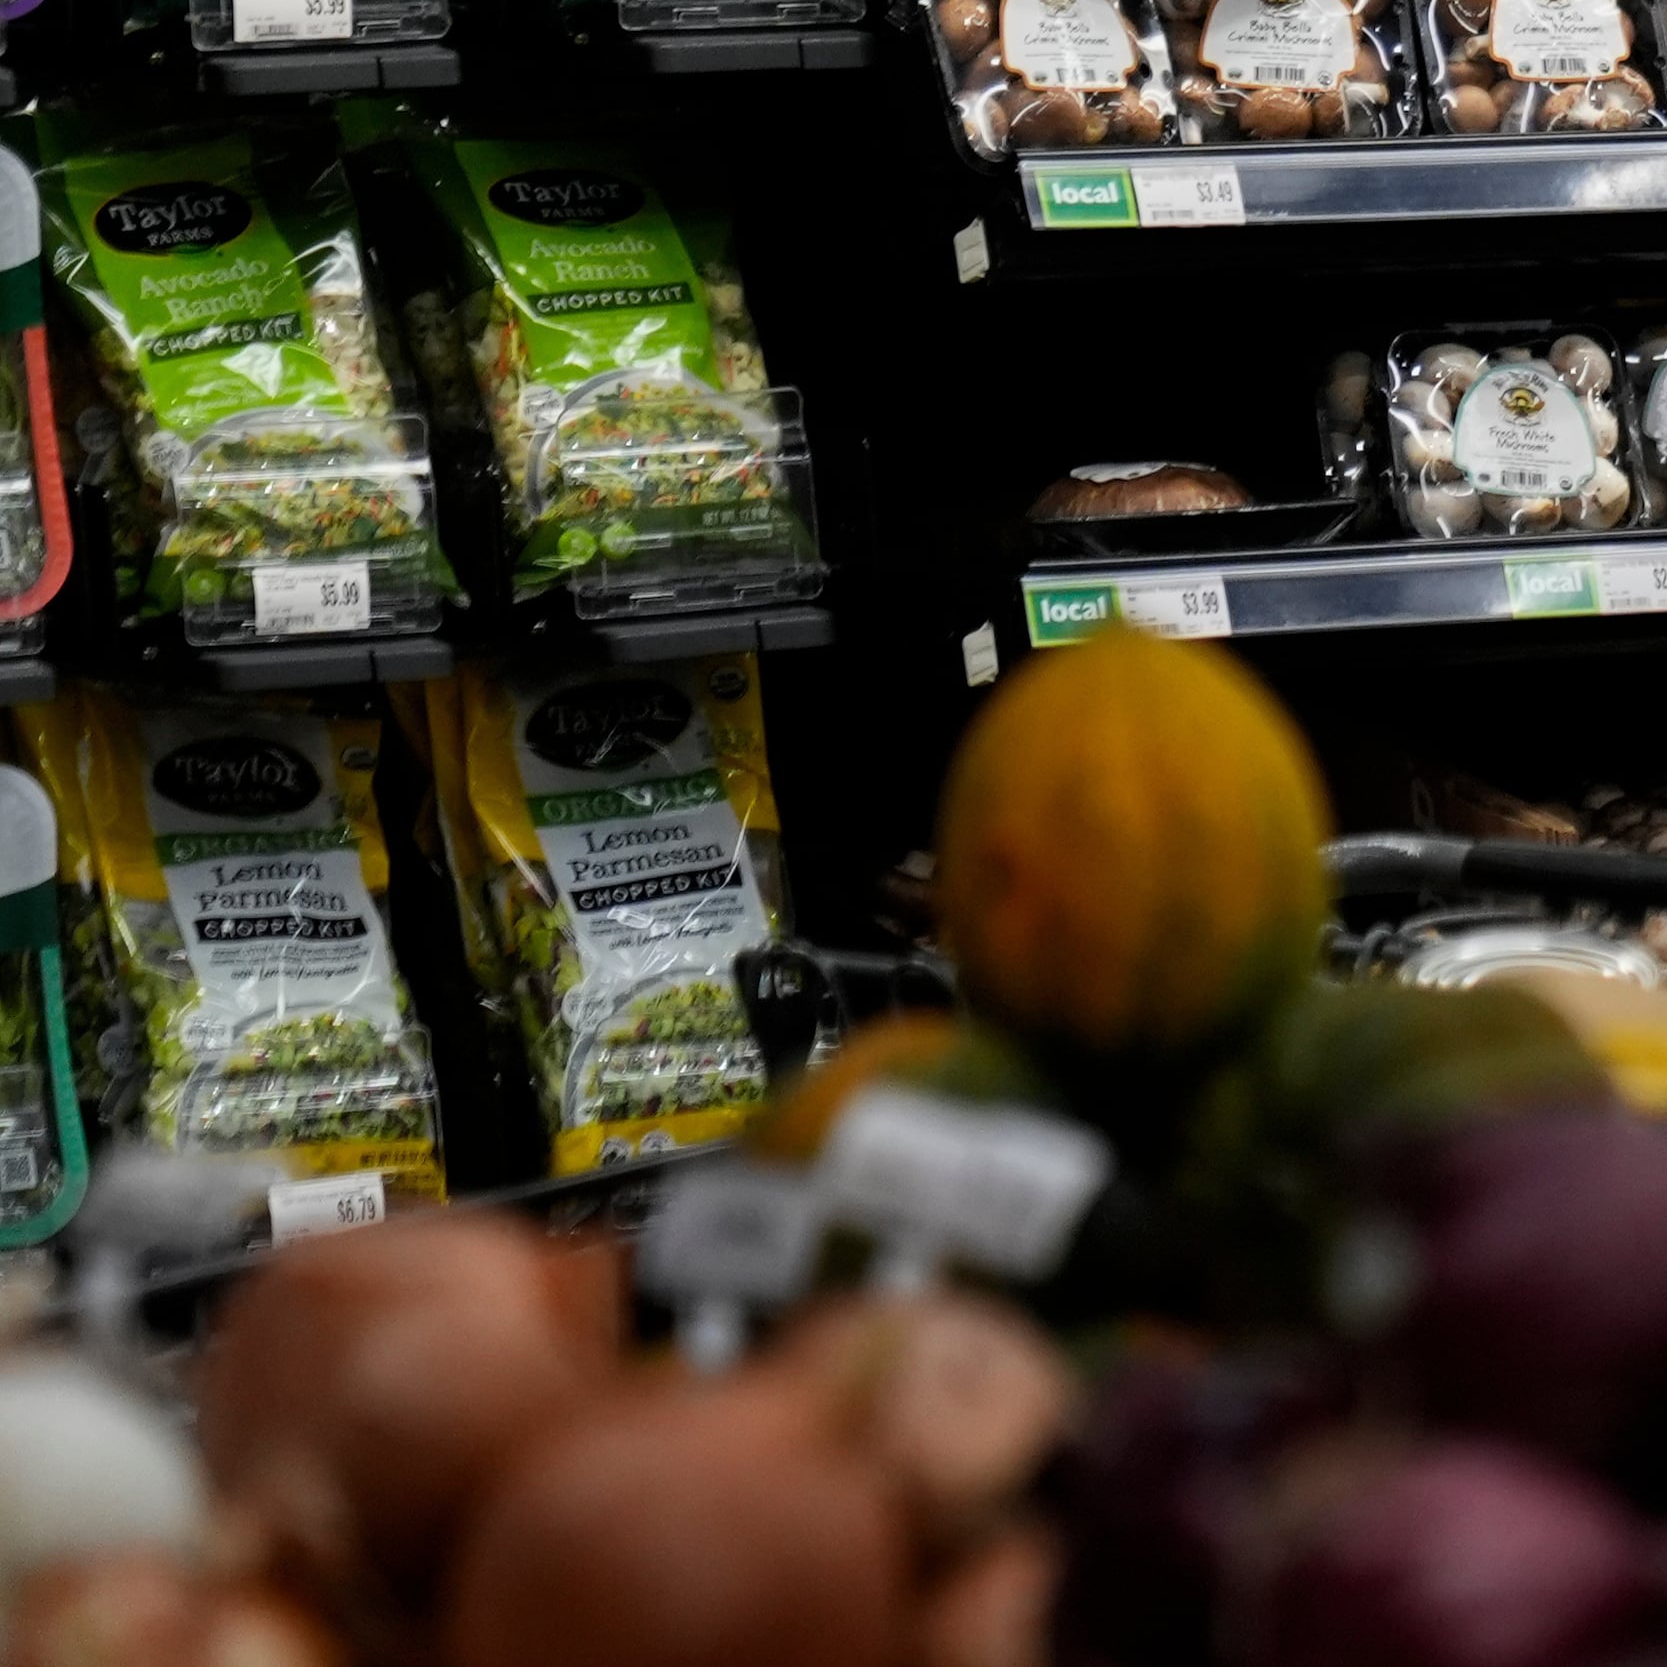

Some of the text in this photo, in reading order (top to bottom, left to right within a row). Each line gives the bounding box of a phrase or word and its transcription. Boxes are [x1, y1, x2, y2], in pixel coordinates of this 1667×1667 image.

[1249, 20, 1312, 34] Baby Bella
[504, 180, 621, 207] Taylor
[1050, 181, 1234, 205] local $3.49
[107, 193, 228, 233] Taylor
[146, 225, 214, 248] FARMS
[529, 236, 656, 259] Avocado
[139, 257, 270, 300] Avocado
[552, 260, 650, 284] Ranch
[165, 286, 264, 325] Ranch
[535, 286, 685, 314] CHOPPED KIT
[259, 313, 295, 338] KIT
[1487, 426, 1556, 444] Fresh White
[320, 581, 361, 608] $5.99
[1518, 570, 1585, 594] local
[1039, 590, 1220, 623] local $3.99
[173, 749, 302, 792] Taylor
[578, 824, 690, 857] Lemon
[210, 860, 323, 887] Lemon
[566, 842, 725, 883] Parmesan
[195, 887, 347, 914] Parmesan
[578, 869, 732, 912] CHOPPED KIT
[318, 919, 357, 938] KIT
[336, 1196, 376, 1224] $6.79
